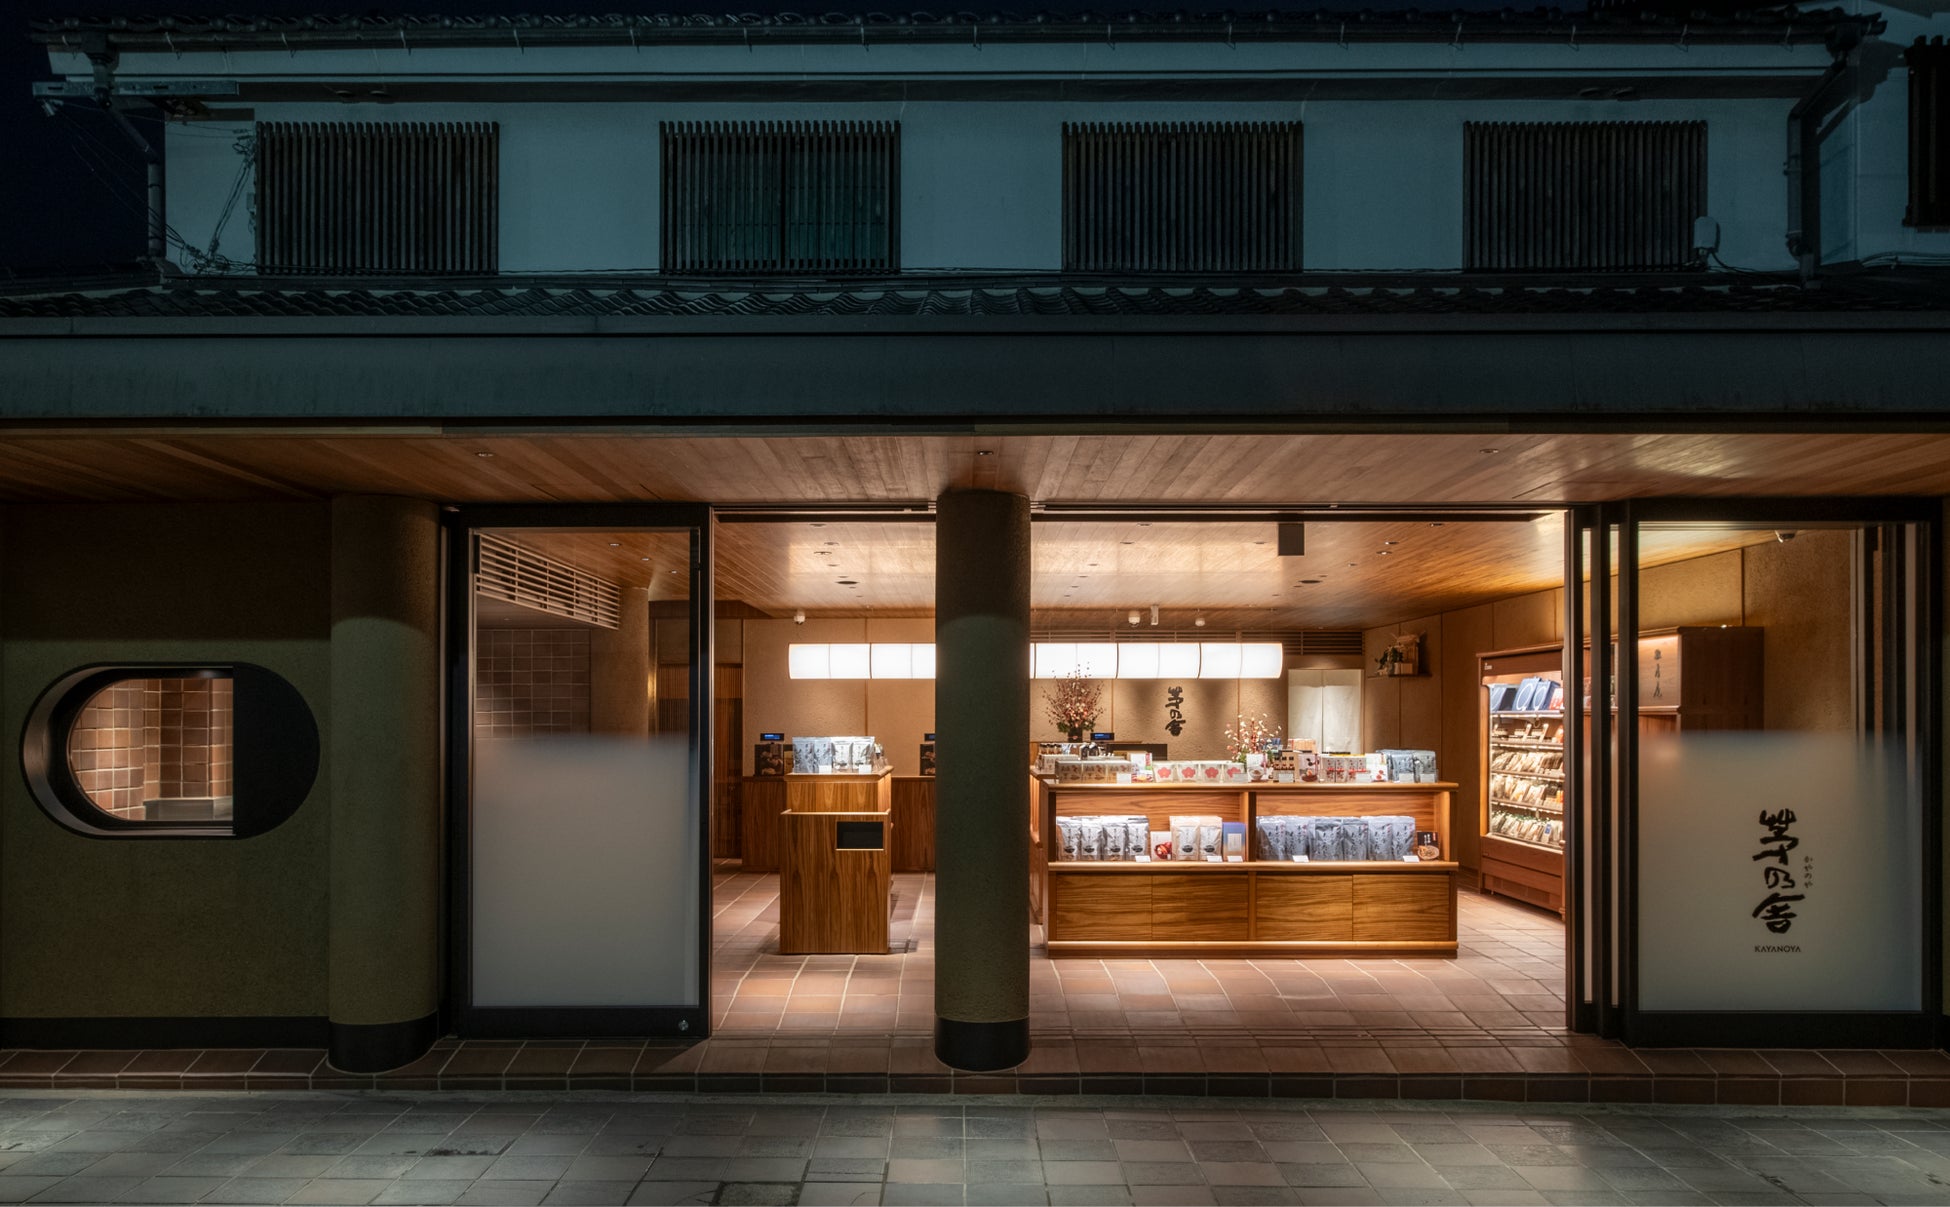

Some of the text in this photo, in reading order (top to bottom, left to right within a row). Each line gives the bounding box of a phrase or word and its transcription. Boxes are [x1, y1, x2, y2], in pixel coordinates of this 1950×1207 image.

[1165, 686, 1186, 737] 茅乃舎
[1752, 808, 1805, 934] 茅乃舎
[1804, 856, 1813, 888] かやのや
[1754, 945, 1801, 953] KAYANOYA
